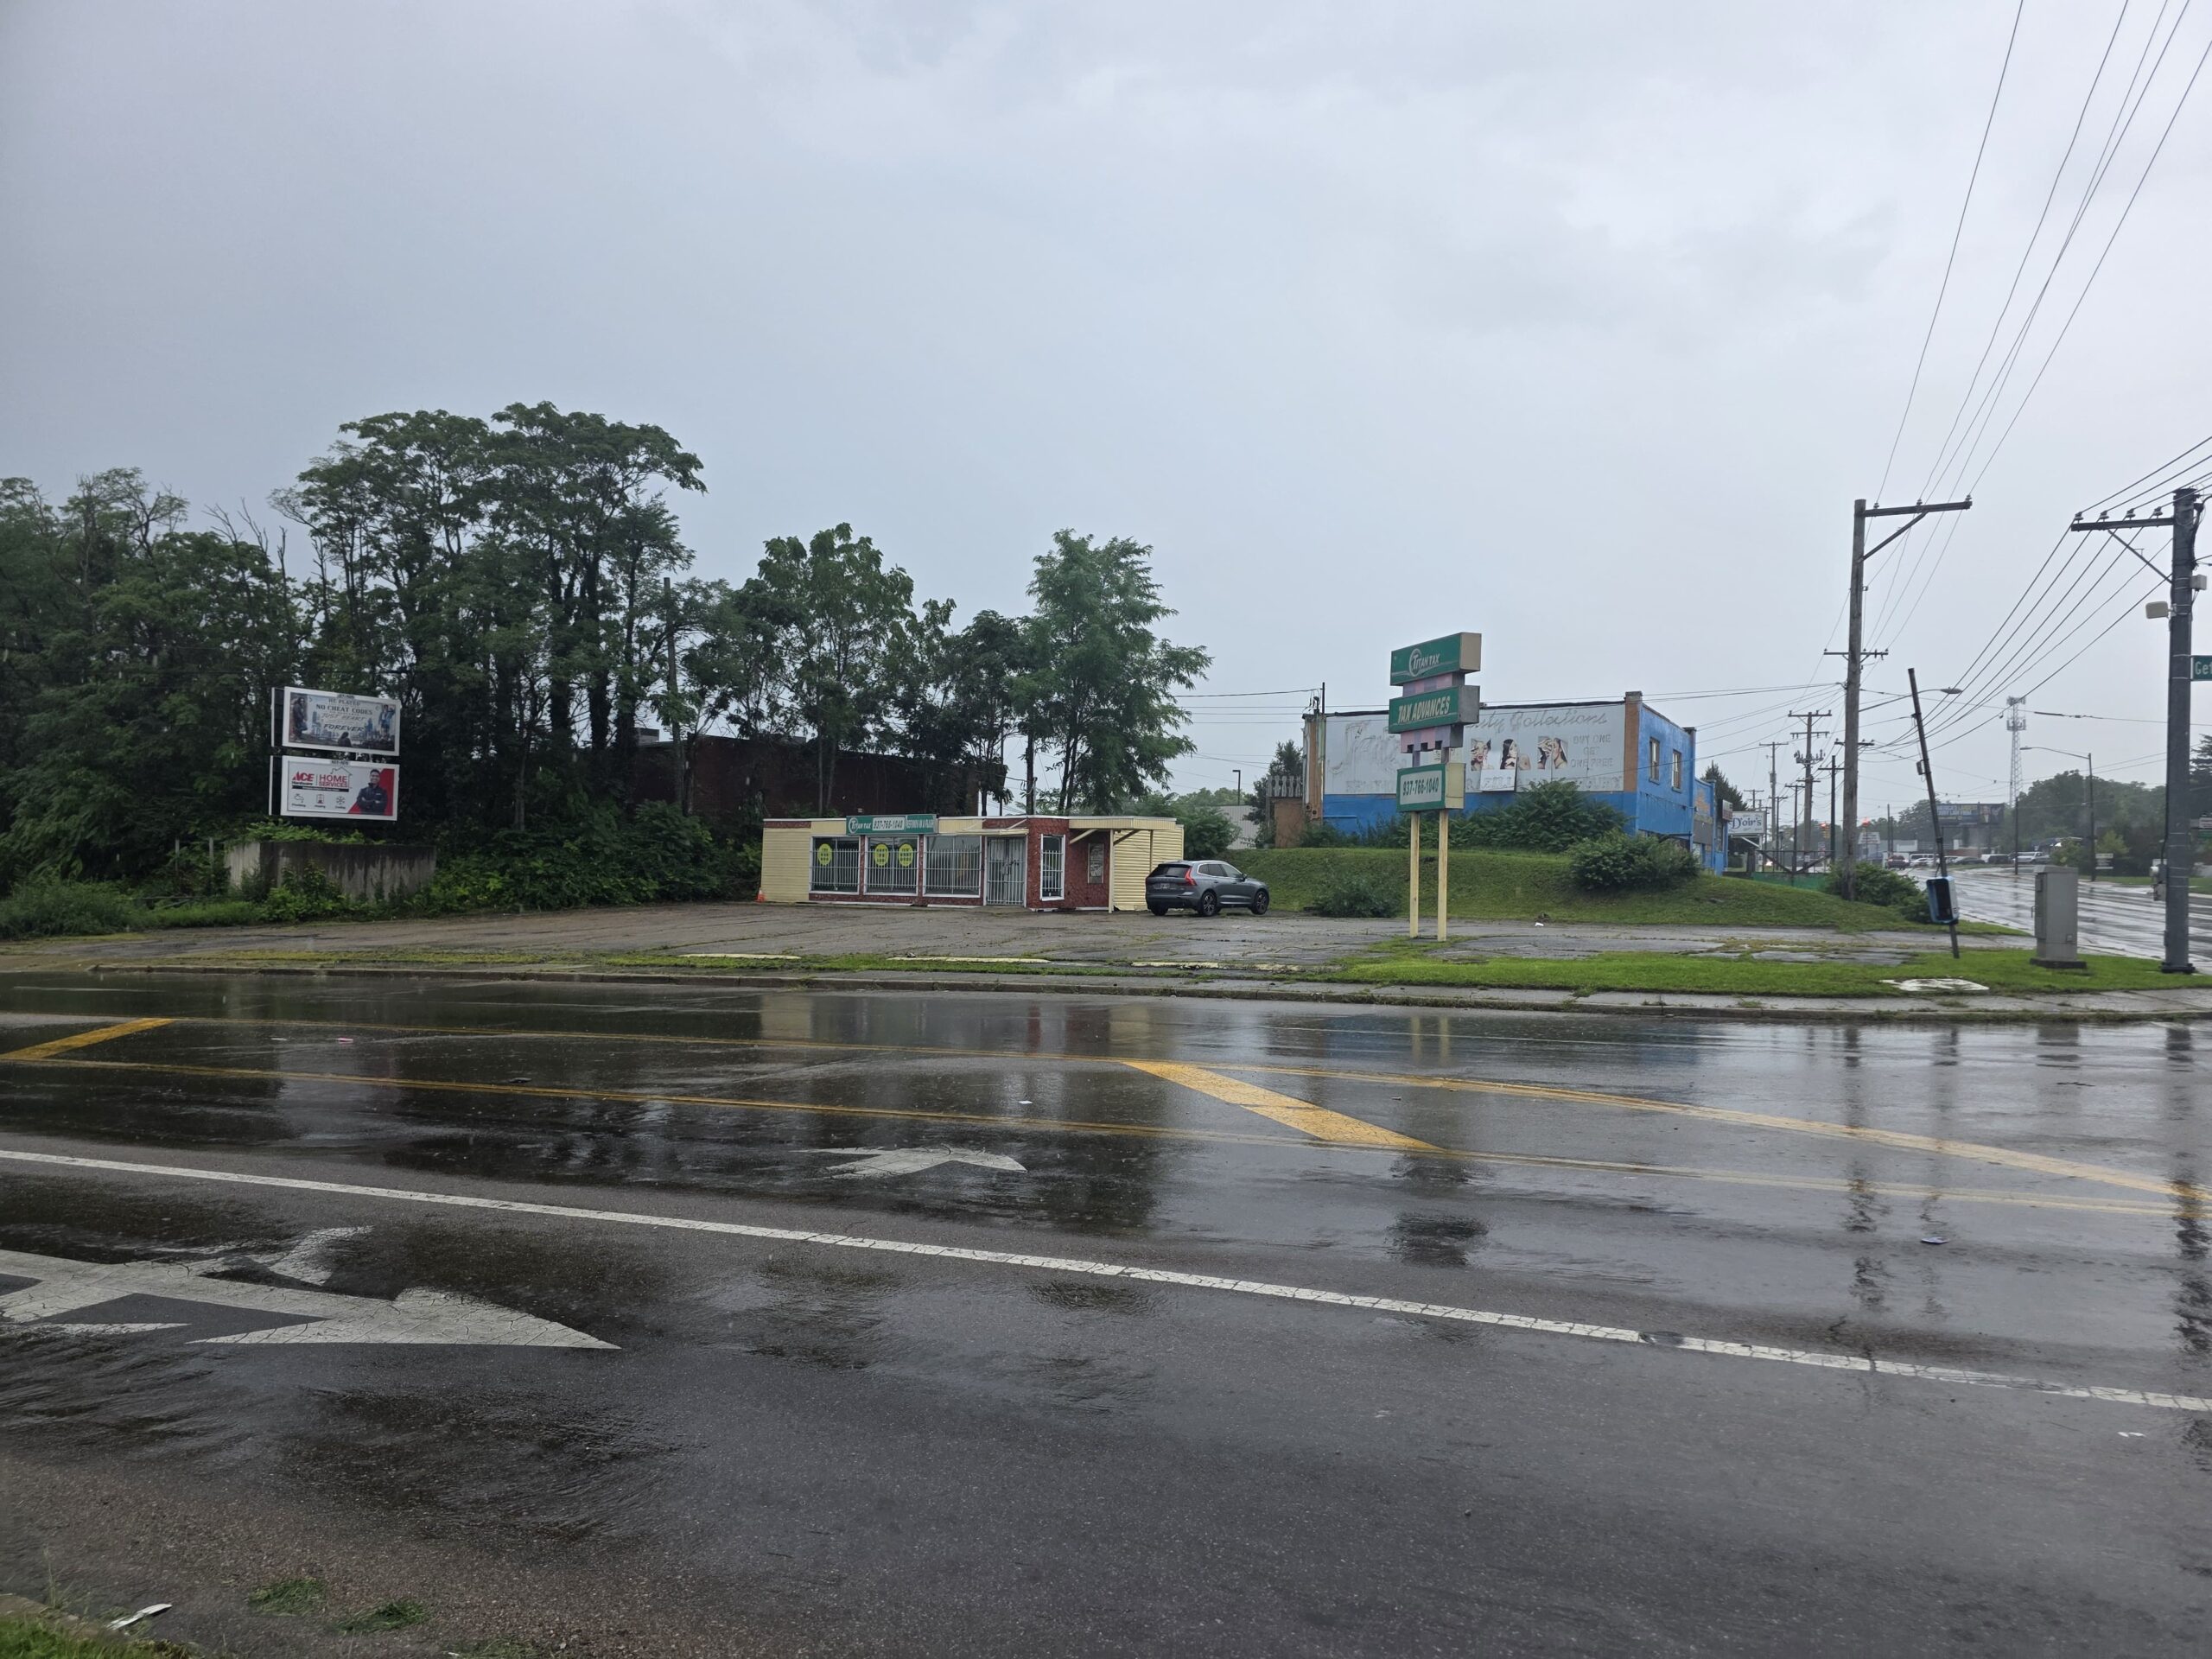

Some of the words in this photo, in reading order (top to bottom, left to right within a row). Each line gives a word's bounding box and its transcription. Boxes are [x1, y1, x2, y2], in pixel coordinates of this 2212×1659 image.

[1398, 704, 1413, 724] TAX
[1412, 696, 1451, 720] ADVANCES
[292, 772, 315, 782] ACE
[319, 774, 347, 783] HOME
